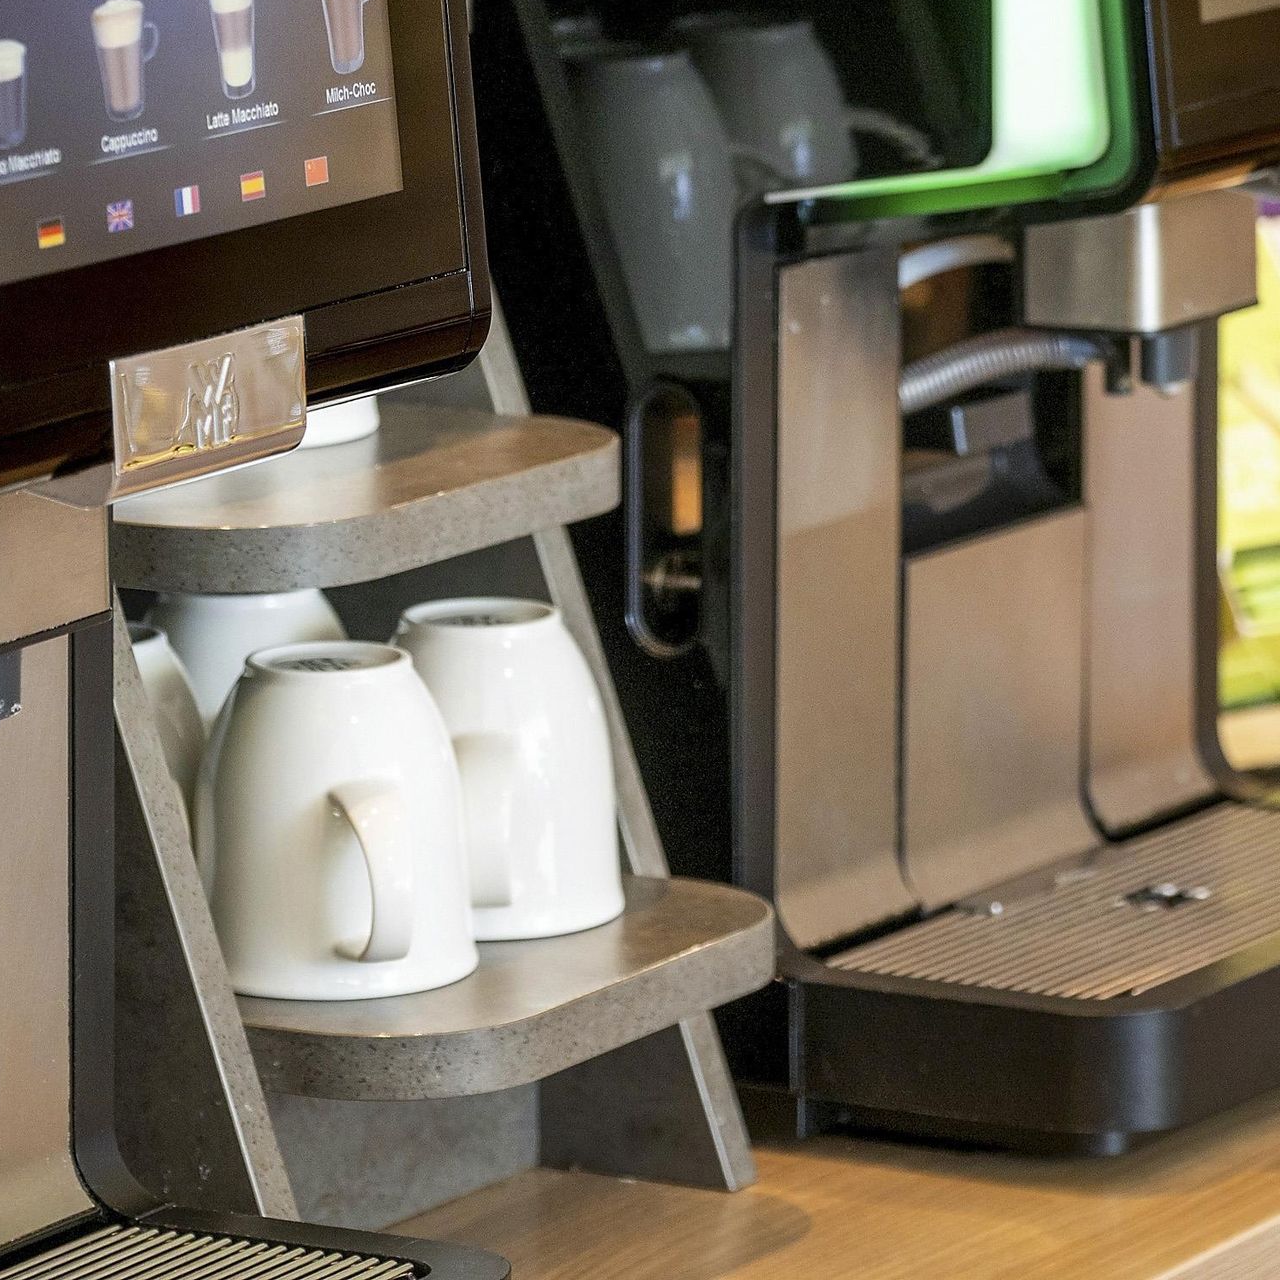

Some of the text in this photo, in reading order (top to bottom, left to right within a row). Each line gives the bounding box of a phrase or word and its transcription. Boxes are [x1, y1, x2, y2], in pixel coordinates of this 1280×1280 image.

[326, 82, 376, 104] Milch-Choc
[206, 101, 279, 130] Latte Macchiato
[101, 128, 158, 154] Cappuccino
